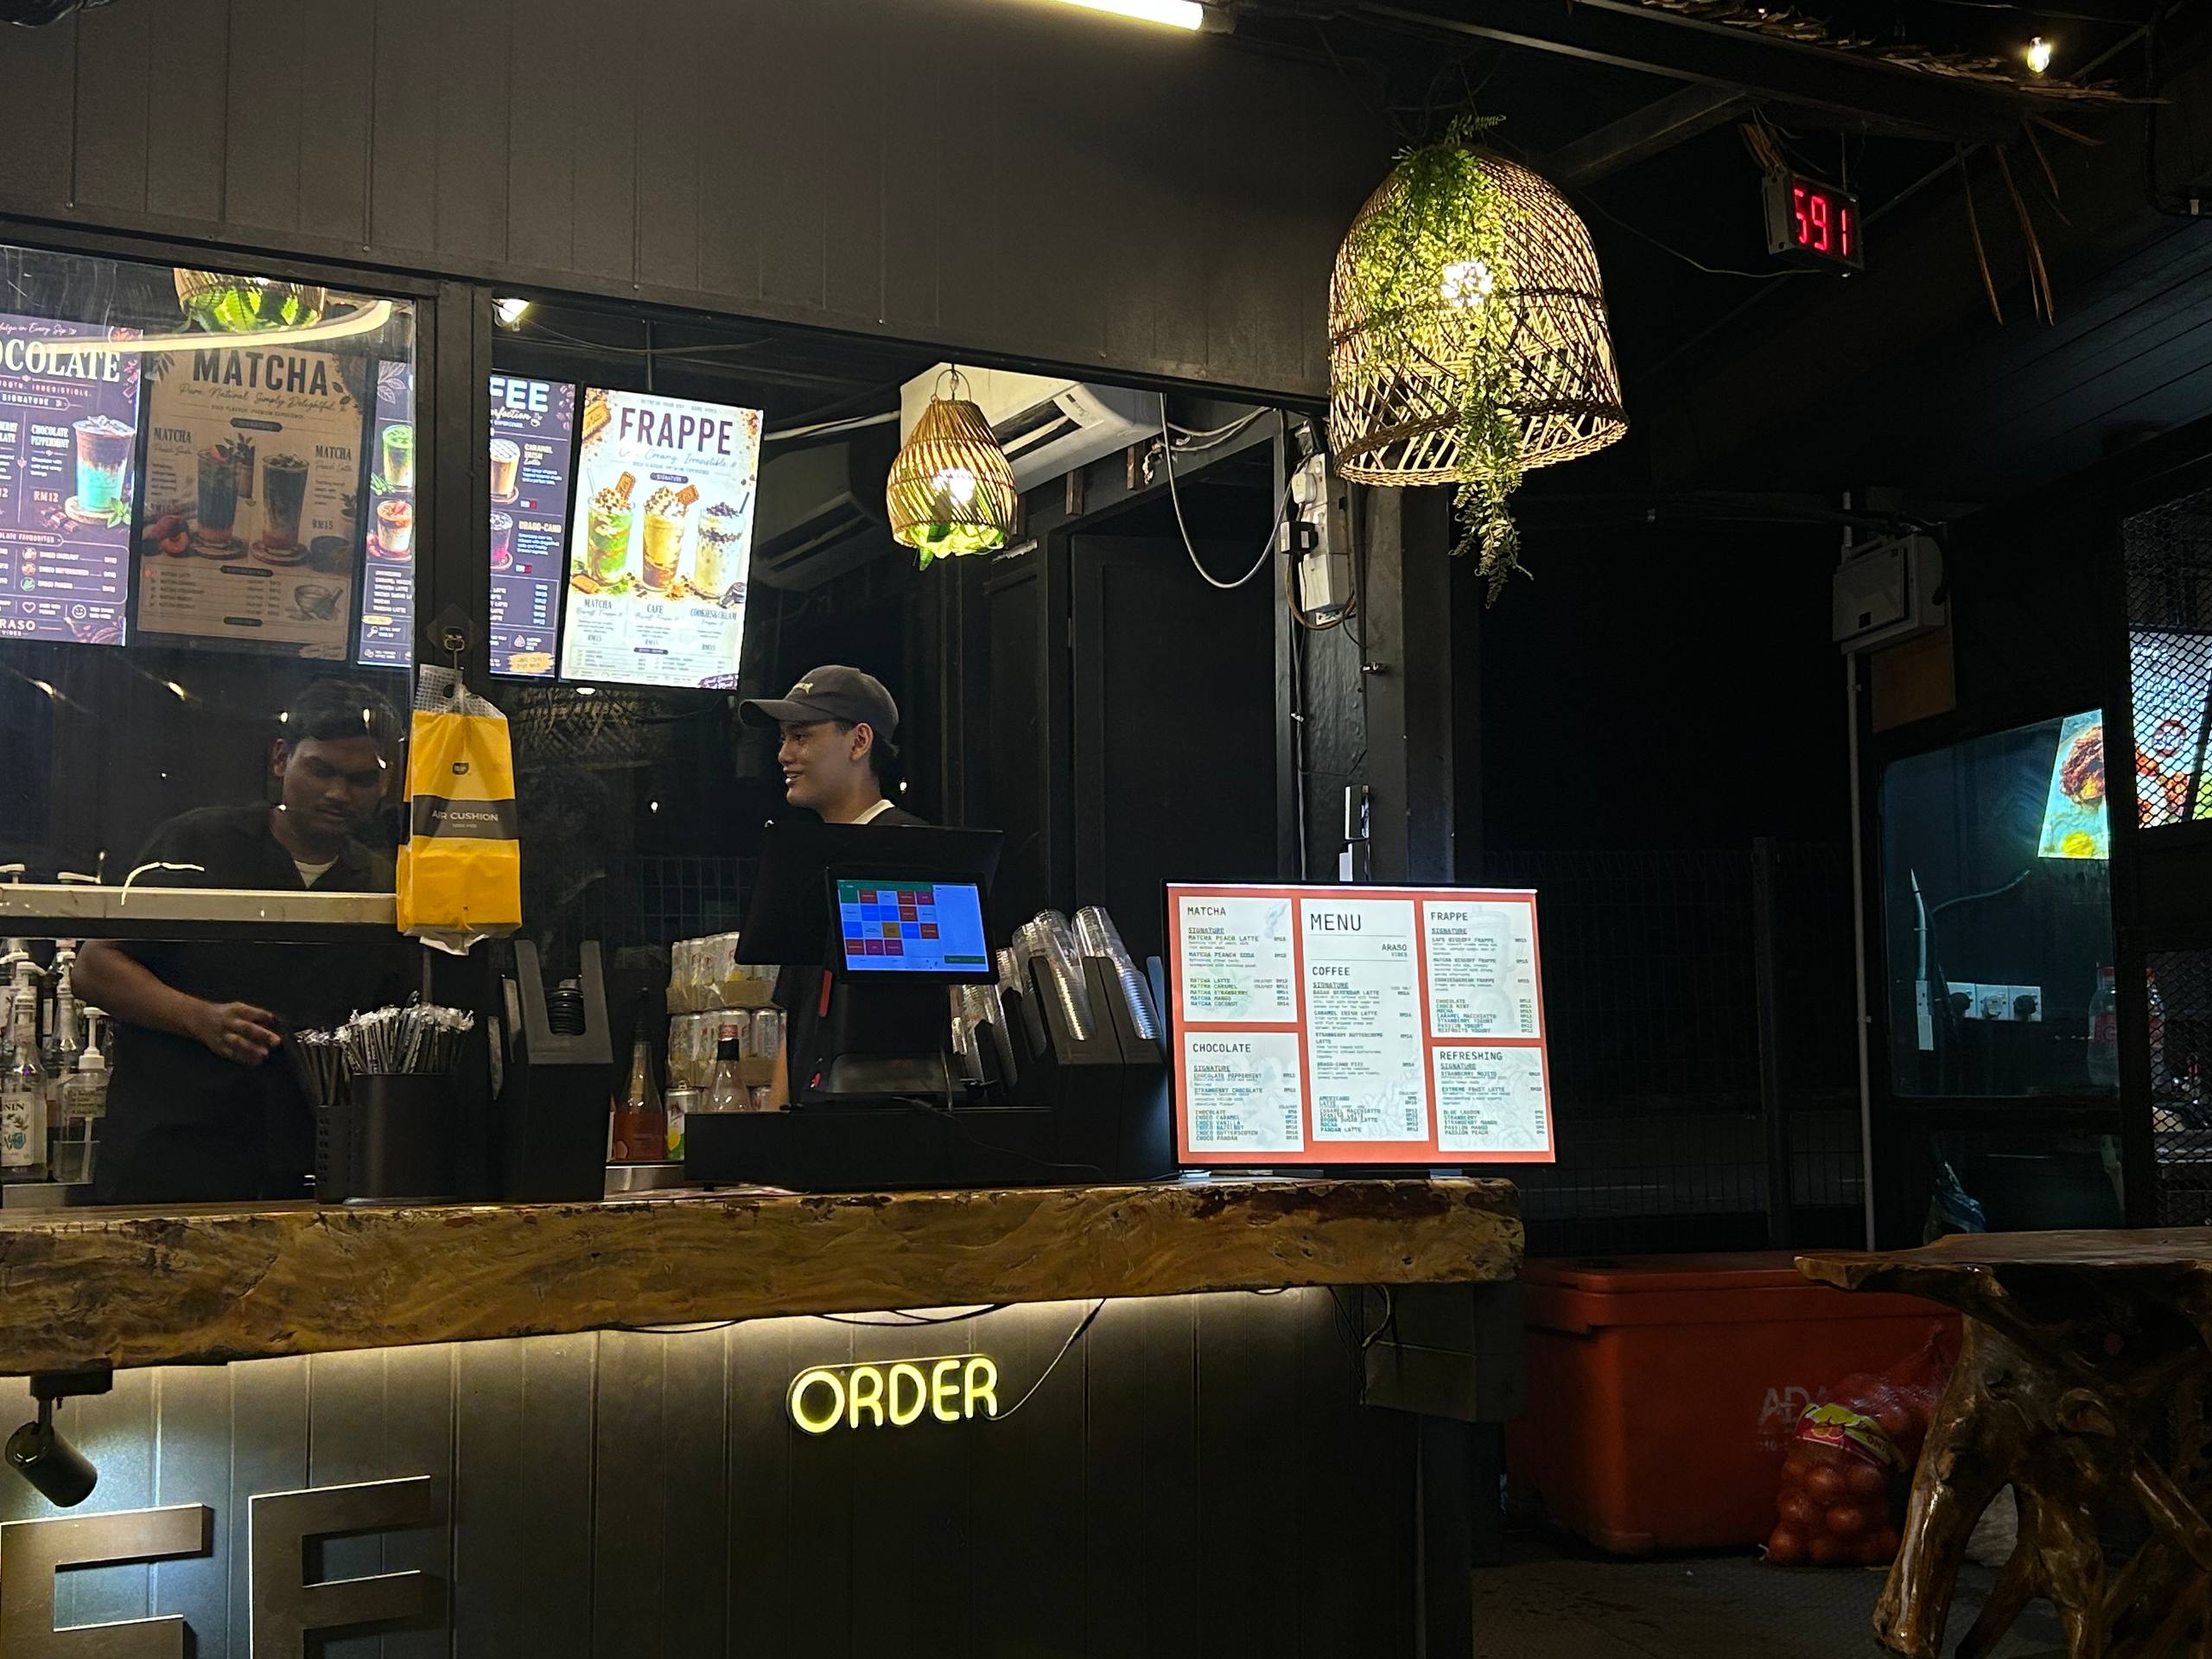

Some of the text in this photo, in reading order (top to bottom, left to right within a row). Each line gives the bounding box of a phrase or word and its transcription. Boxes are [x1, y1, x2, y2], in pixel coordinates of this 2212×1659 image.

[1793, 188, 1847, 257] 591
[0, 339, 121, 383] COLATE
[193, 347, 328, 397] MATCHA
[3, 393, 49, 405] SIGNATURE
[31, 424, 69, 437] CHOCOLATE
[154, 428, 192, 444] MATCHA
[620, 407, 733, 456] FRAPPE
[315, 444, 352, 461] MATCHA
[34, 491, 59, 503] RM12
[584, 599, 612, 609] MATCHA
[646, 604, 663, 613] CAFE
[432, 810, 499, 822] AIR CUSHION
[1187, 906, 1226, 916] MATCHA
[1430, 912, 1469, 921] FRAPPE
[1310, 913, 1361, 931] MENU
[1312, 967, 1350, 976] COFFEE
[1192, 1043, 1251, 1053] CHOCOLATE
[1440, 1052, 1503, 1060] REFRESHING
[791, 1357, 998, 1433] ORDER
